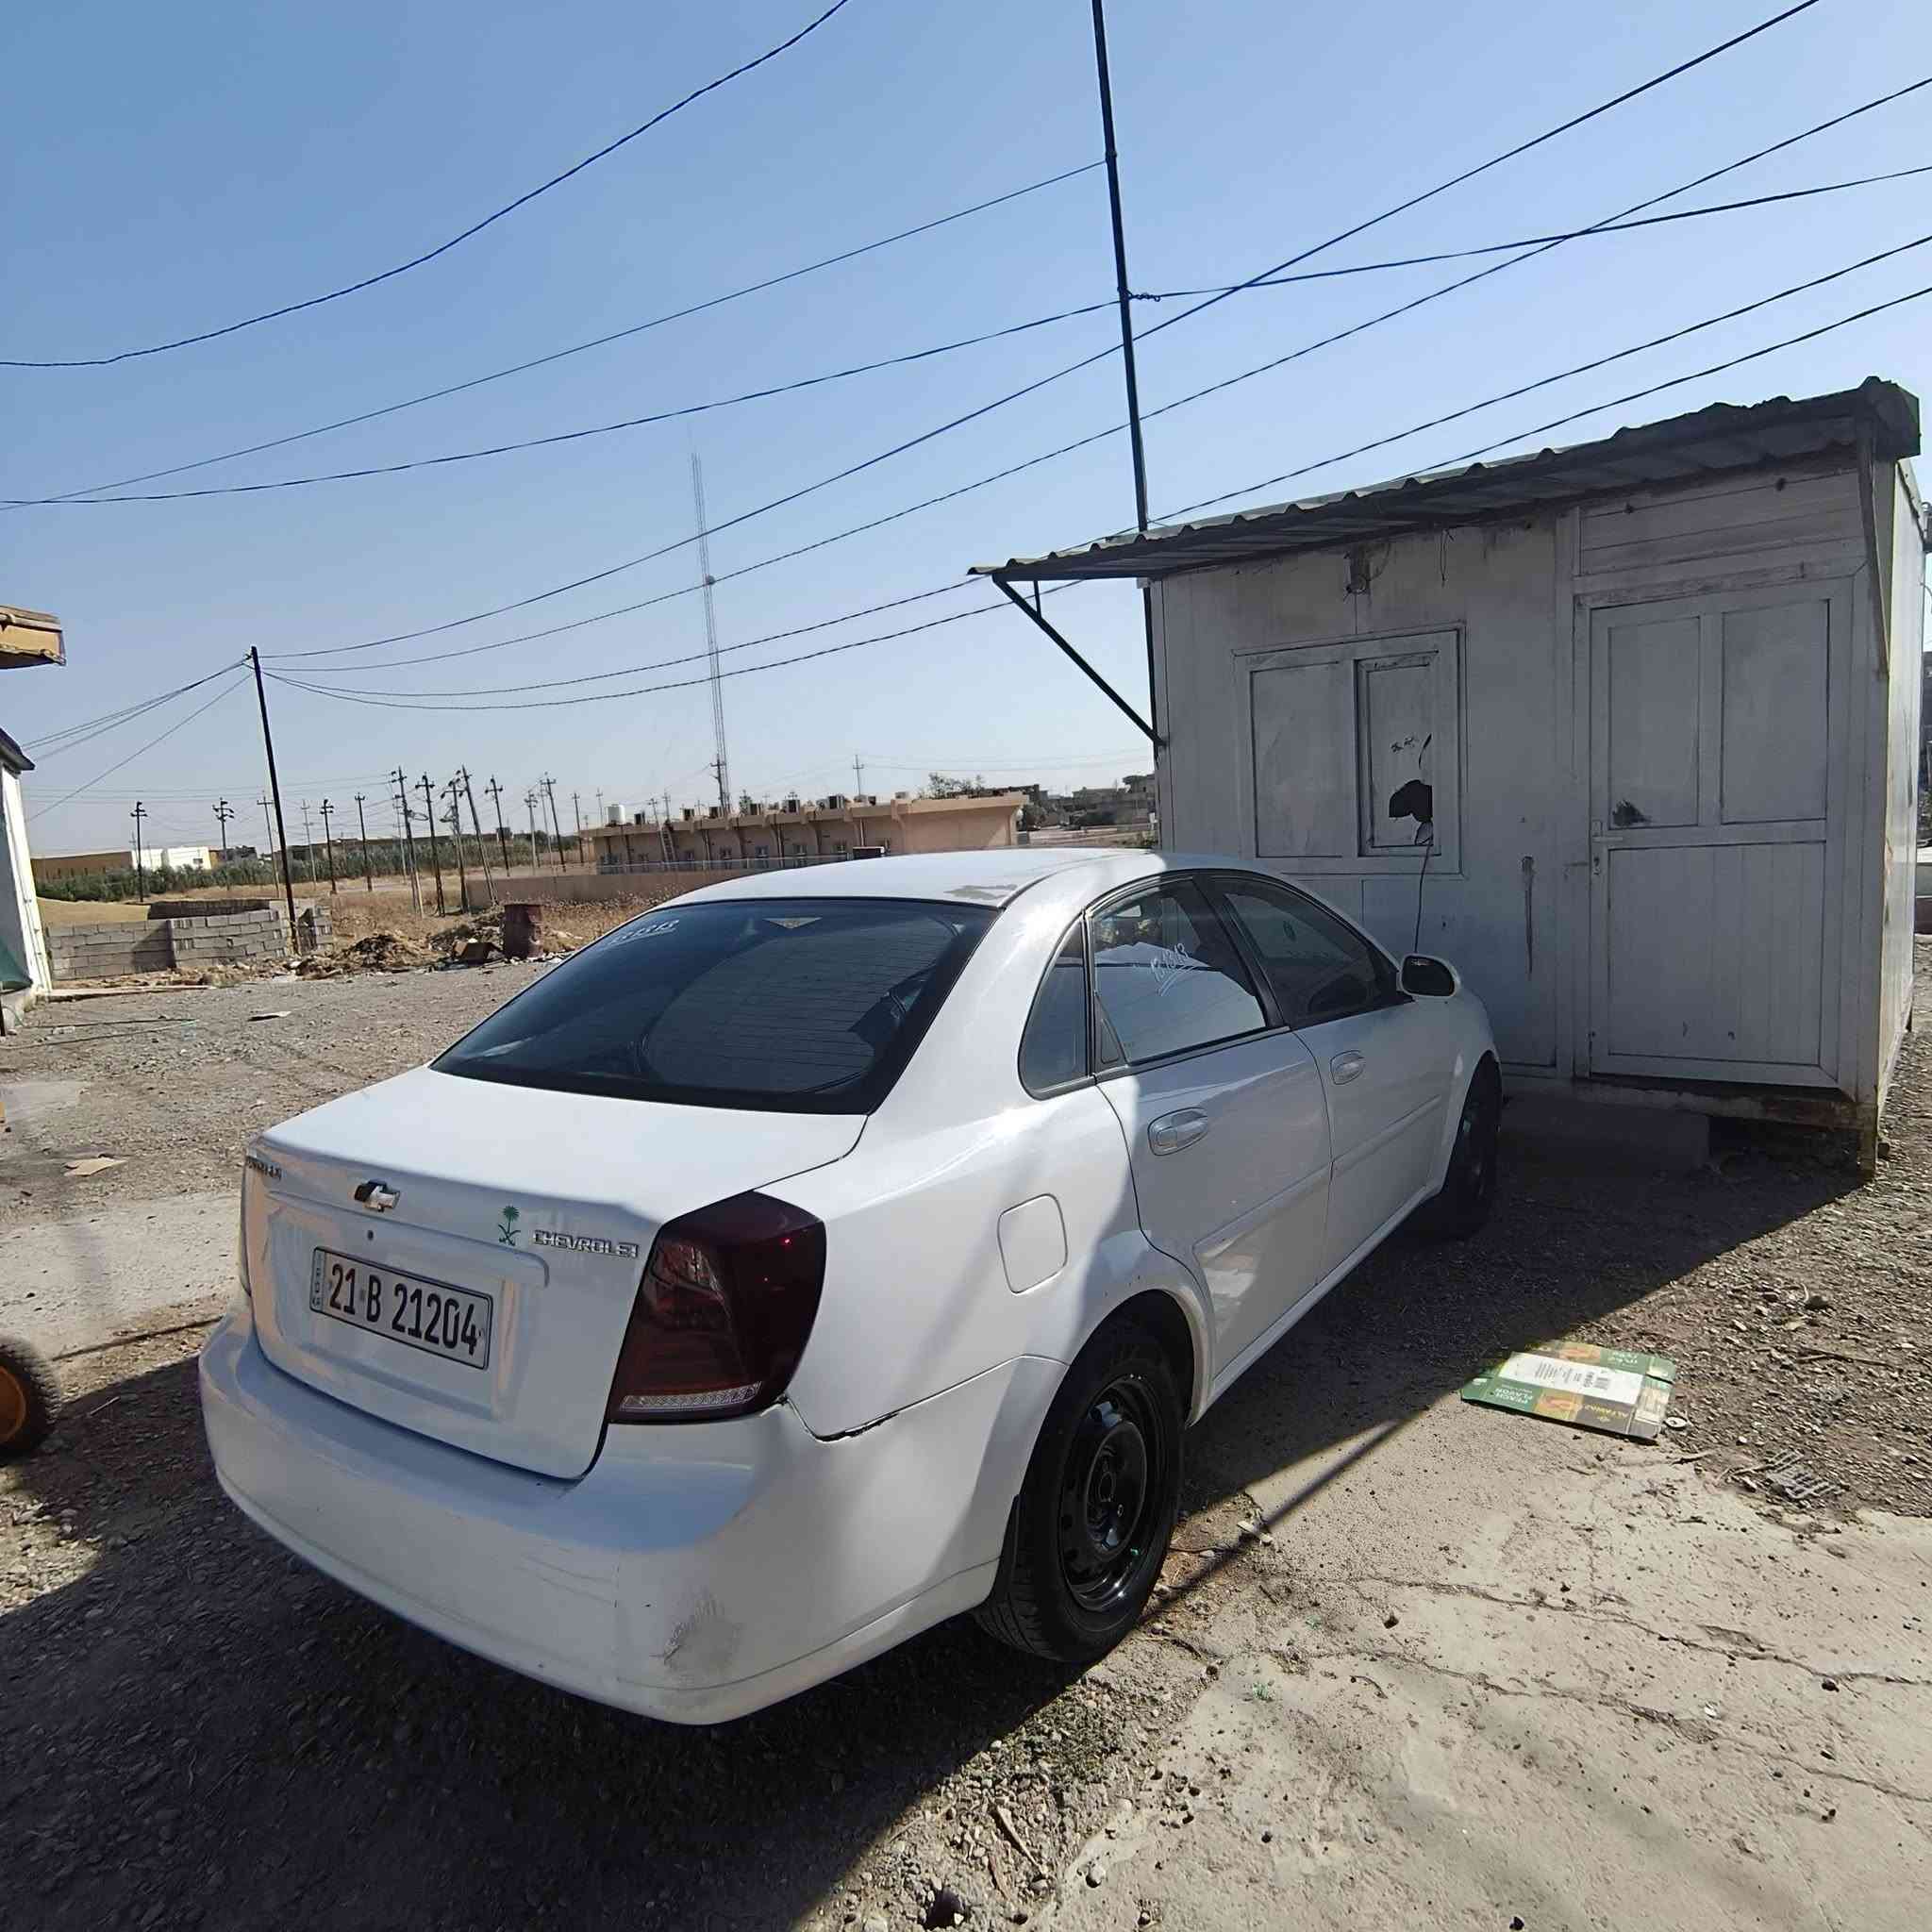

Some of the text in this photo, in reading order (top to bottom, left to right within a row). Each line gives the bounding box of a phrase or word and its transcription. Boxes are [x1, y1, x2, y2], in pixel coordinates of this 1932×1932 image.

[532, 1229, 639, 1258] CHEVROLET
[329, 1262, 357, 1315] 21
[366, 1274, 382, 1324] B
[391, 1282, 478, 1357] 21204
